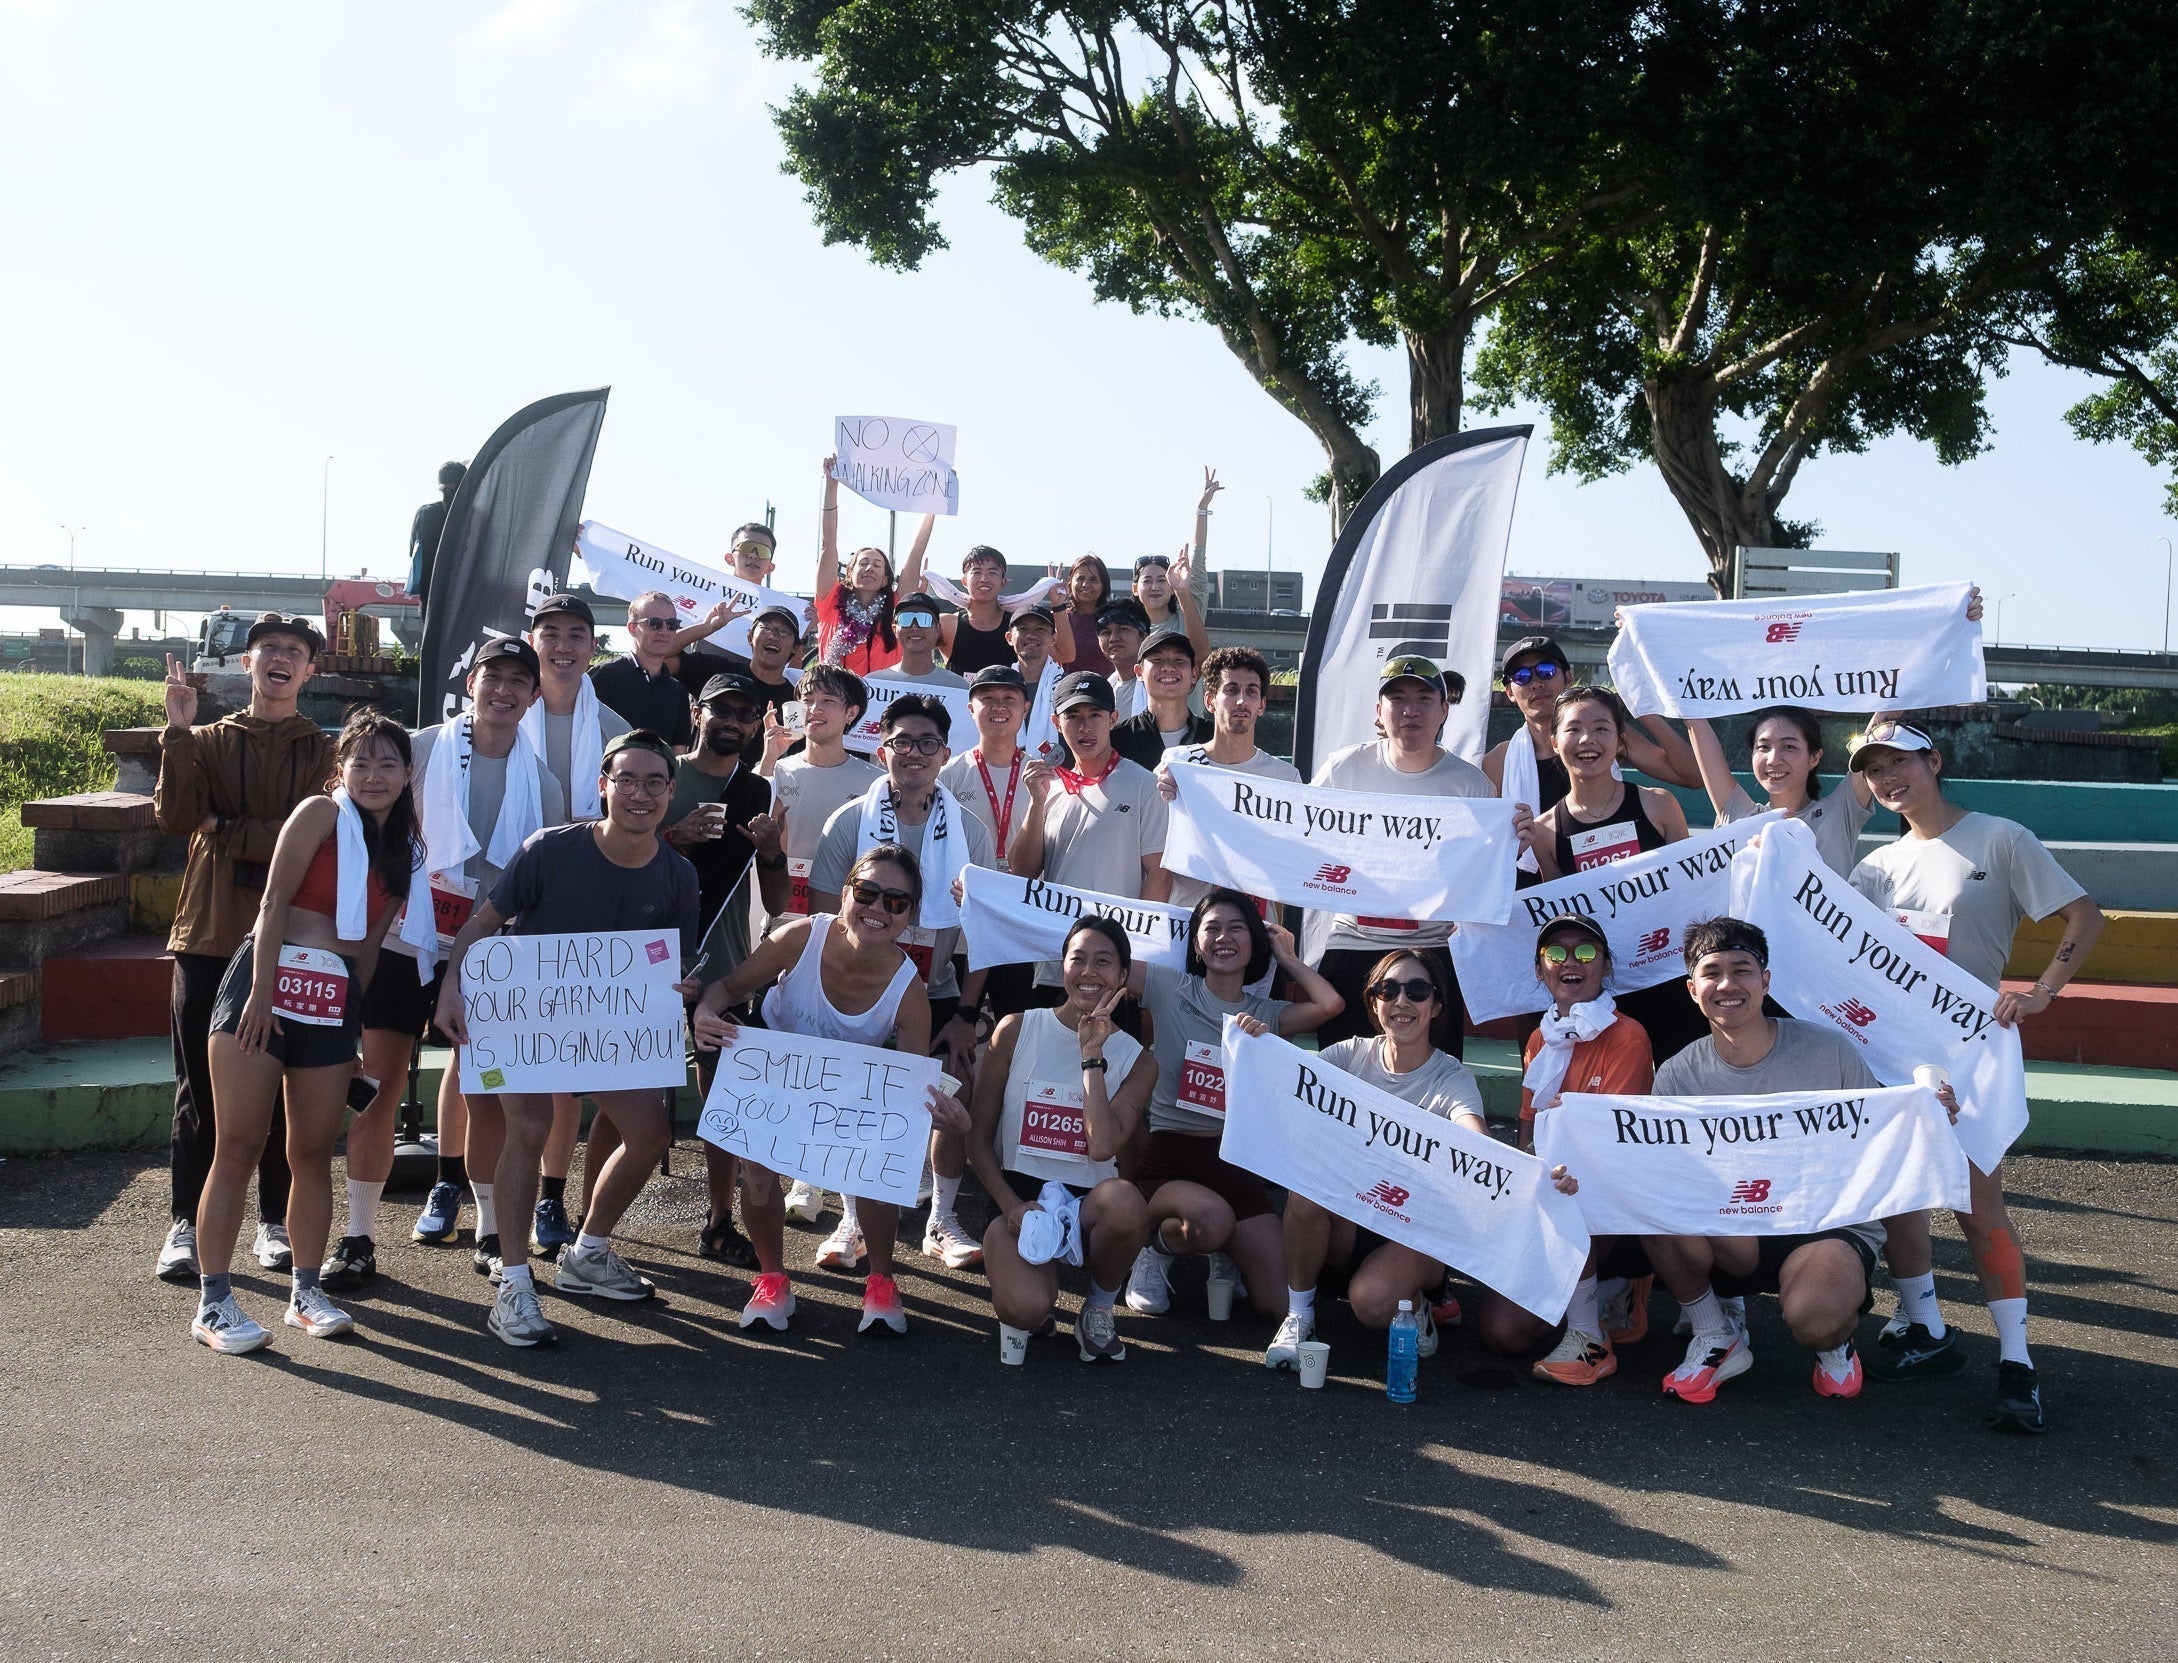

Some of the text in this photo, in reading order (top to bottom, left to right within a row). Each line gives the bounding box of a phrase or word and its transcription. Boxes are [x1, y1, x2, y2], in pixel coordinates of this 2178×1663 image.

[841, 418, 889, 450] NO
[835, 461, 954, 499] WALKING ZONE
[624, 543, 759, 610] Run your way.
[1612, 591, 1666, 604] TOYOTA
[1754, 612, 1813, 621] new balance
[1678, 665, 1901, 701] Run your way.
[1232, 781, 1442, 850] Run your way.
[1021, 878, 1083, 919] Run
[1303, 881, 1357, 896] new balance
[1522, 893, 1597, 928] Run
[1598, 865, 1670, 918] your
[464, 936, 633, 985] GO HARD
[1628, 945, 1684, 969] new balance
[1793, 869, 1996, 1043] Run your way.
[279, 976, 337, 1000] 03115
[465, 983, 647, 1023] YOUR GARMIN
[468, 1020, 681, 1068] IS JUDGING YOU!
[1819, 1004, 1869, 1046] new balance
[734, 1048, 911, 1107] SMILE IF
[1186, 1069, 1225, 1092] 1022
[724, 1087, 909, 1141] YOU PEED
[1027, 1110, 1084, 1133] 01265
[1294, 1063, 1514, 1201] Run your way.
[1611, 1097, 1870, 1155] Run your way.
[720, 1128, 906, 1188] A LITTLE
[1029, 1134, 1053, 1145] ALLISON
[1053, 1137, 1067, 1147] SHIH
[1355, 1191, 1411, 1224] new balance
[1719, 1203, 1783, 1215] new balance
